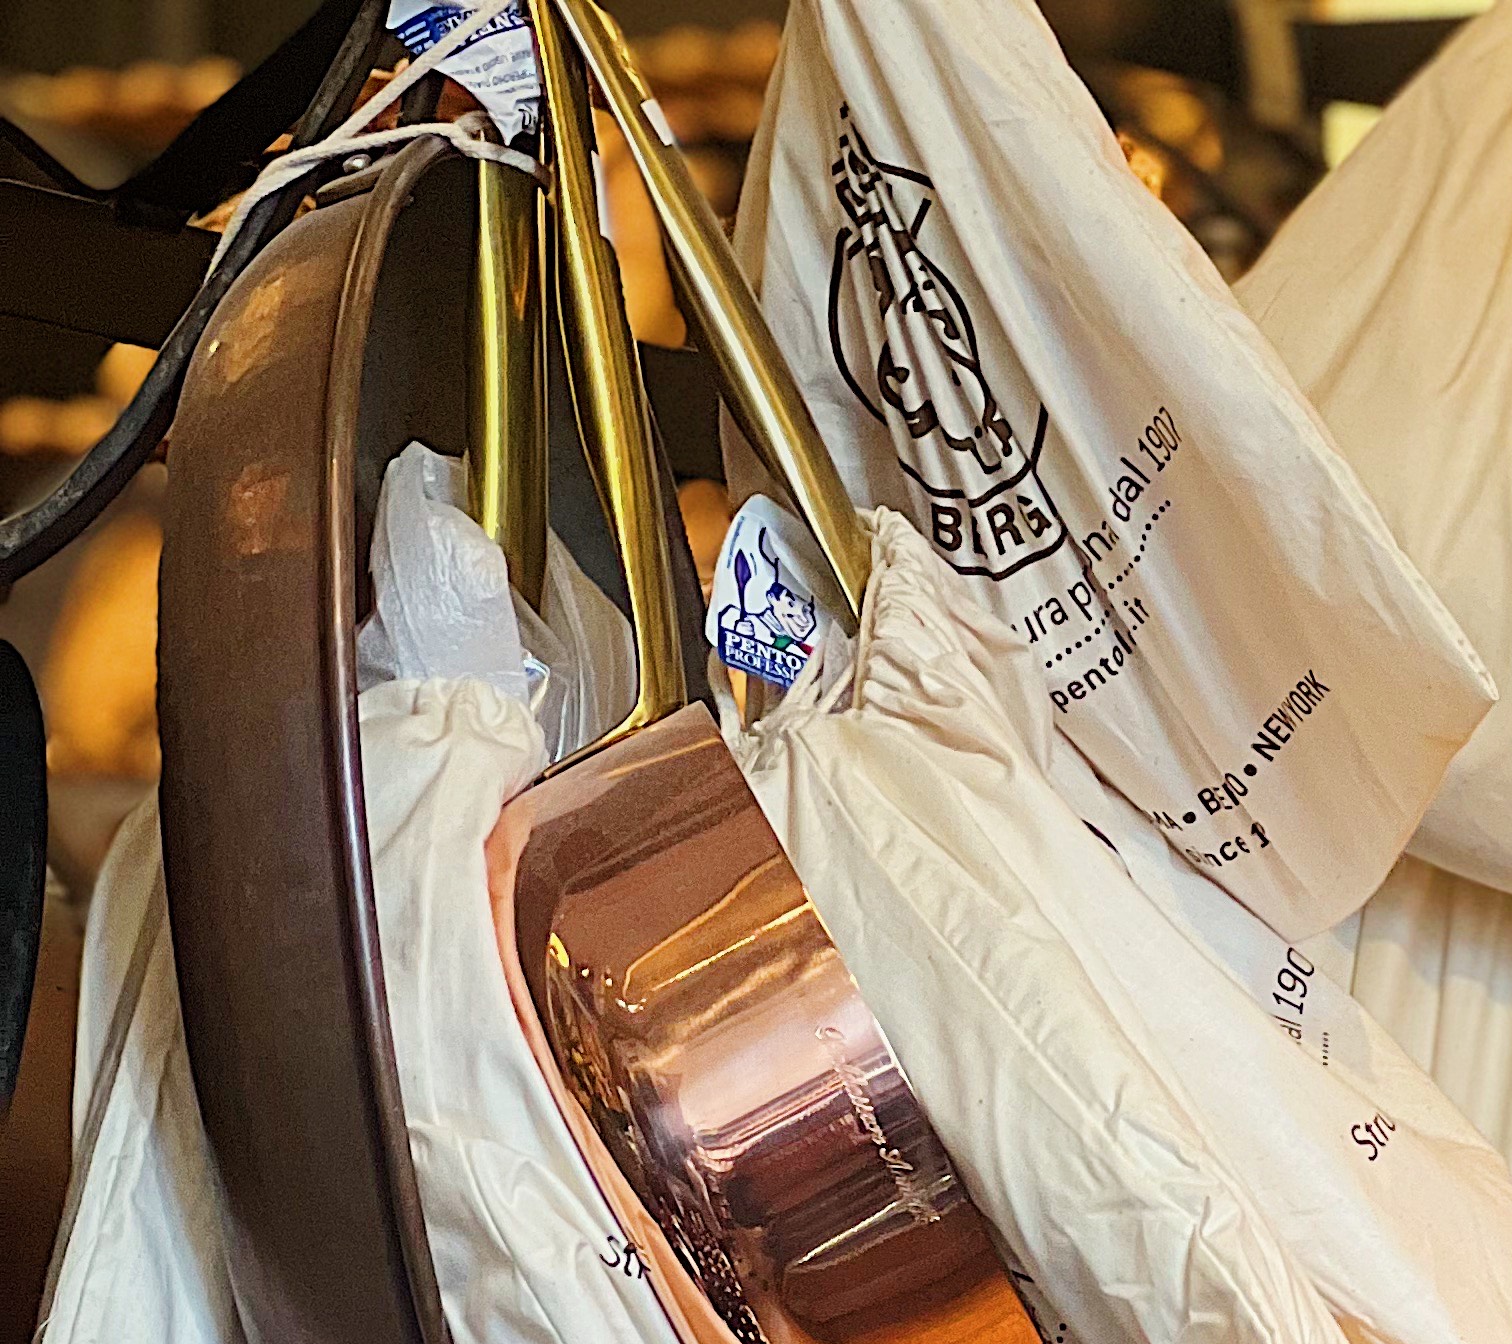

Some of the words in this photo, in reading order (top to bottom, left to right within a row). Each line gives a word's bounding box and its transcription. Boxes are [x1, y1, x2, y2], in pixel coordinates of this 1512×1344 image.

[1109, 456, 1150, 521] dal
[1138, 406, 1182, 472] 1907
[1251, 669, 1331, 762] NEWYORK
